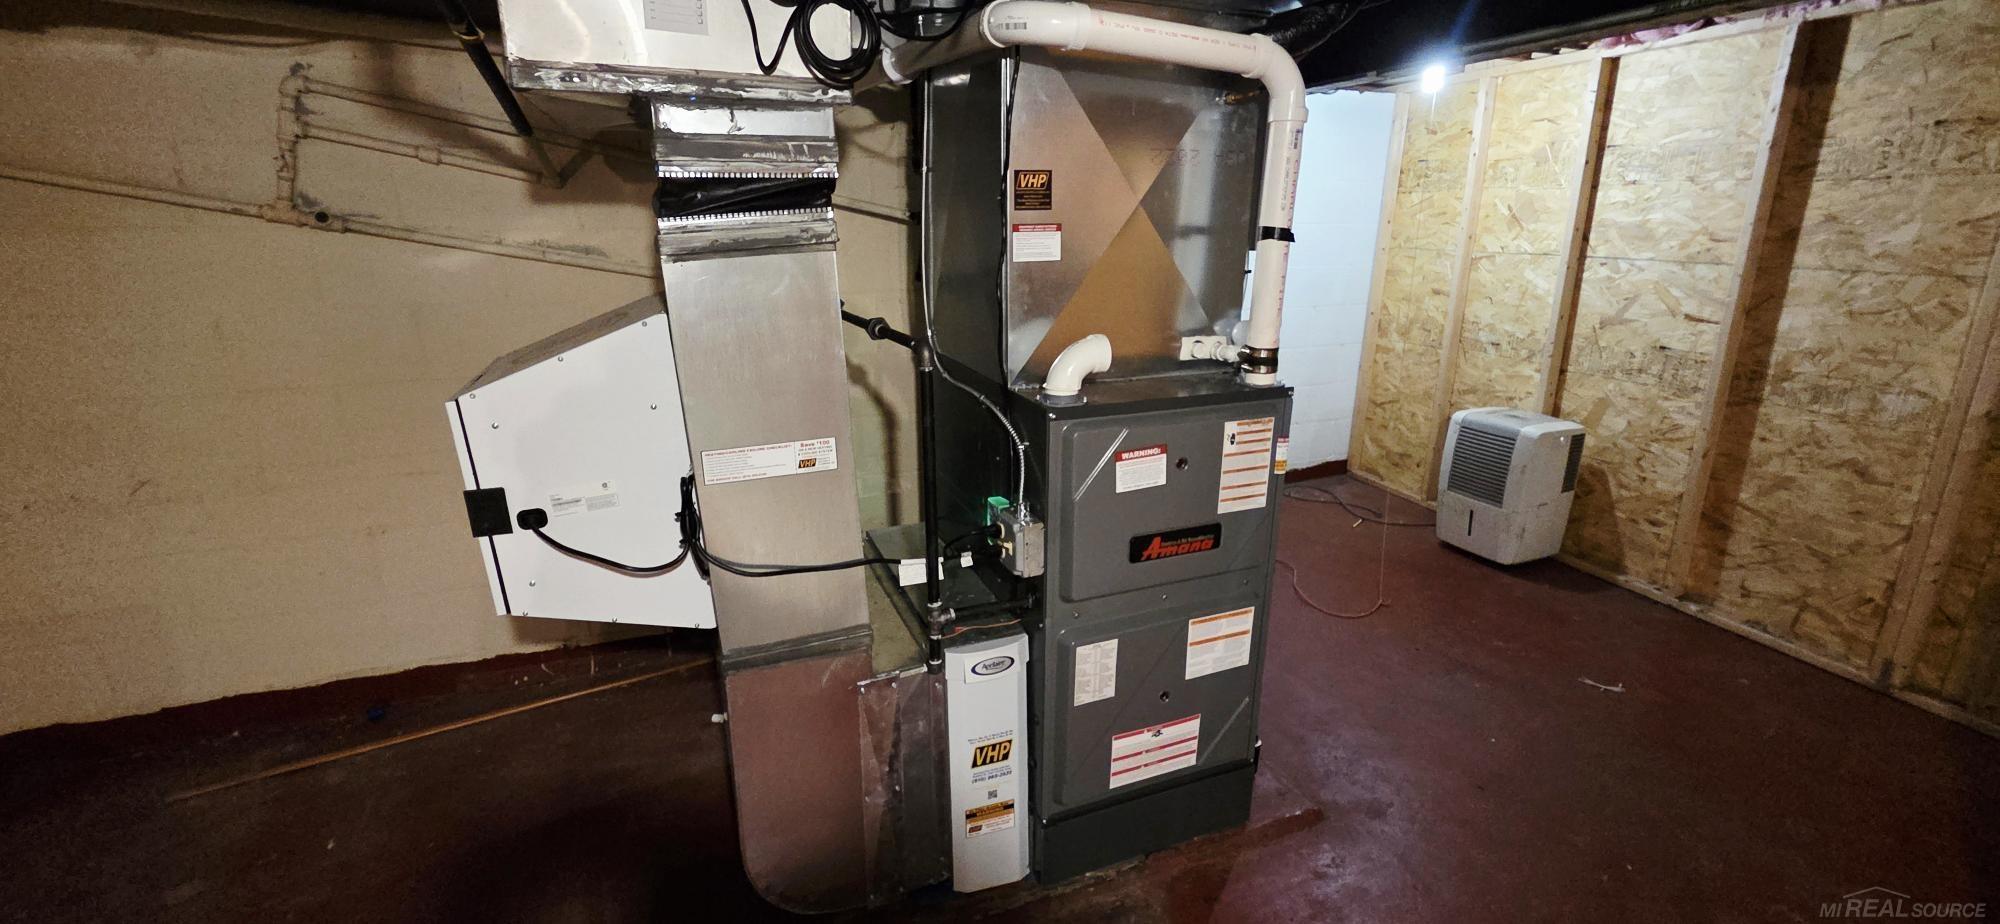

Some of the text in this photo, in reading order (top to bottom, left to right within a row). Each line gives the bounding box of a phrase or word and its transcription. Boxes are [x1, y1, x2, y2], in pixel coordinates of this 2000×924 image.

[1019, 174, 1047, 187] VHP
[1121, 447, 1161, 459] WARNING:
[800, 459, 816, 468] VHP
[1140, 535, 1214, 561] Amana
[976, 742, 1011, 767] VHP
